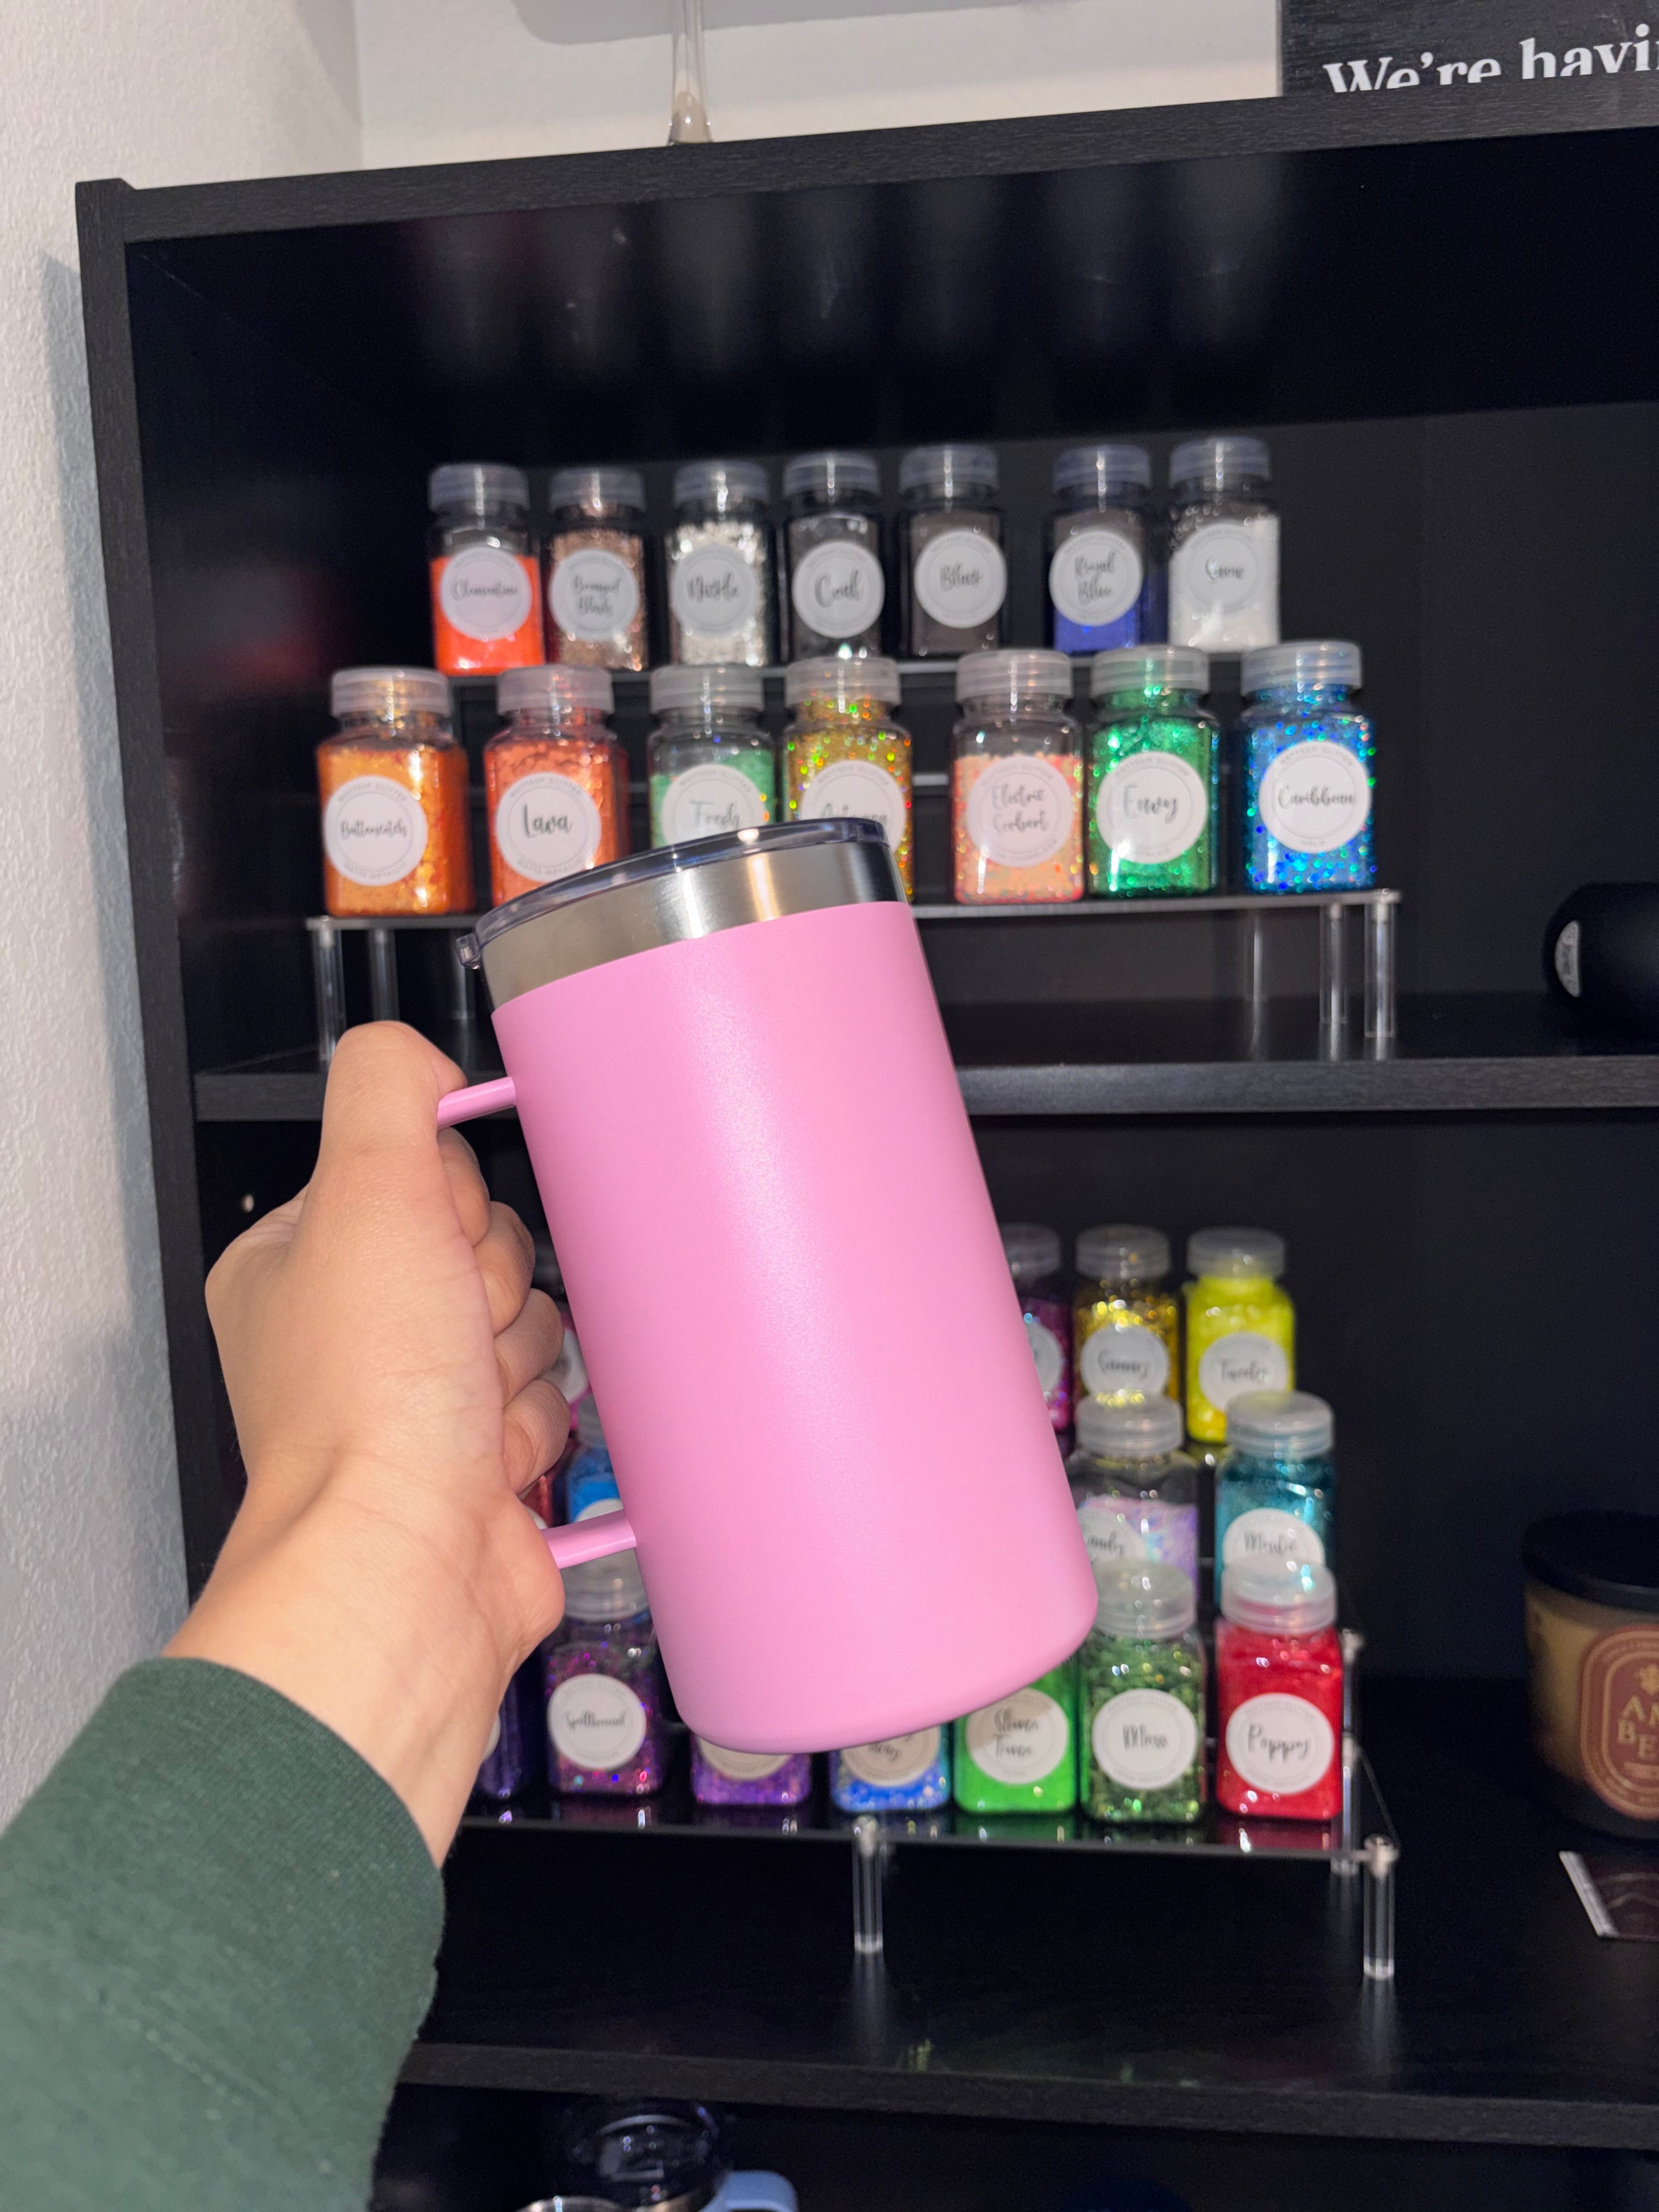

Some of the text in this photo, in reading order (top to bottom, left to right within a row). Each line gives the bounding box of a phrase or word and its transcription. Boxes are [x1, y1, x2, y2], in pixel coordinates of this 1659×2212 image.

[1322, 24, 1659, 93] We're havi
[1122, 783, 1179, 823] Envy
[1278, 785, 1355, 809] Caribbean
[522, 804, 573, 838] Lava
[1248, 1722, 1311, 1763] Poppy
